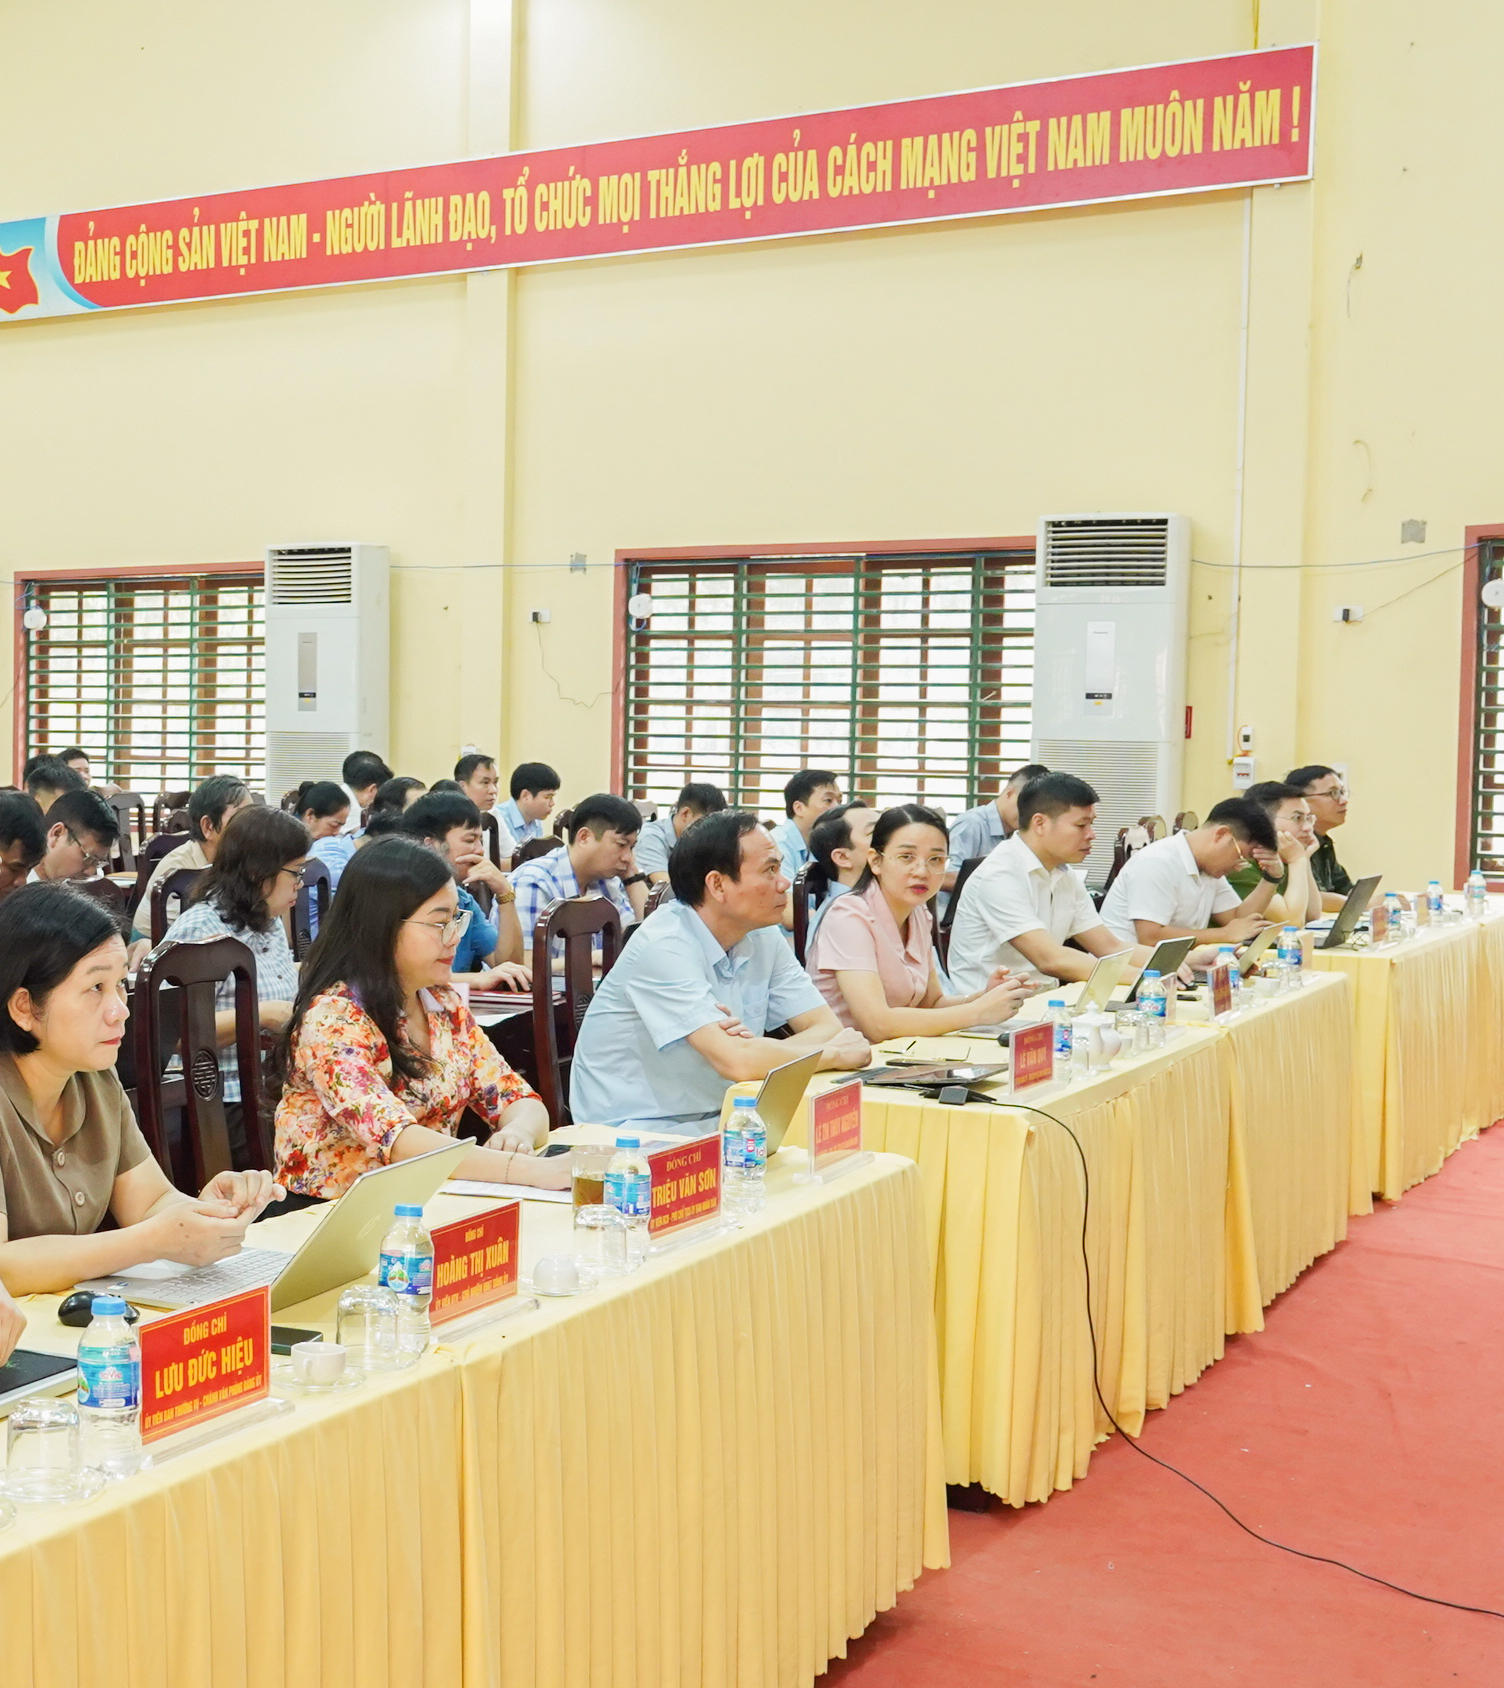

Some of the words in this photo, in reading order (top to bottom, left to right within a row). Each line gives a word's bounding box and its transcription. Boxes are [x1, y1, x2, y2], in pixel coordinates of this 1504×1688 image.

[73, 220, 121, 285] ĐẢNG
[125, 225, 173, 287] CỘNG
[178, 207, 216, 271] SẢN
[220, 216, 259, 276] VIỆT
[264, 213, 307, 263] NAM
[312, 232, 321, 243] -
[325, 193, 385, 256] NGƯỜI
[391, 191, 444, 248] LÃNH
[448, 190, 496, 250] ĐẠO,
[502, 166, 530, 236] TỔ
[534, 165, 592, 232] CHỨC
[598, 172, 641, 233] MỌI
[647, 149, 722, 219] THẮNG
[728, 152, 765, 219] LỢI
[772, 129, 820, 204] CỦA
[827, 133, 893, 198] CÁCH
[900, 128, 976, 199] MẠNG
[984, 110, 1041, 188] VIỆT
[1047, 110, 1112, 171] NAM
[1119, 89, 1205, 163] MUÔN
[1211, 80, 1282, 152] NĂM
[1290, 86, 1301, 142] !
[688, 1148, 701, 1164] CHÍ
[652, 1178, 676, 1207] TRIỆU
[679, 1172, 696, 1198] VĂN
[698, 1168, 715, 1192] SƠN
[436, 1254, 467, 1288] HOÀNG
[470, 1248, 483, 1277] THỊ
[485, 1236, 508, 1270] XUÂN
[183, 1320, 208, 1345] ĐỒNG
[211, 1311, 226, 1336] CHÍ
[155, 1361, 183, 1398] LƯU
[188, 1349, 216, 1387] ĐỨC
[221, 1336, 253, 1375] HIỆU
